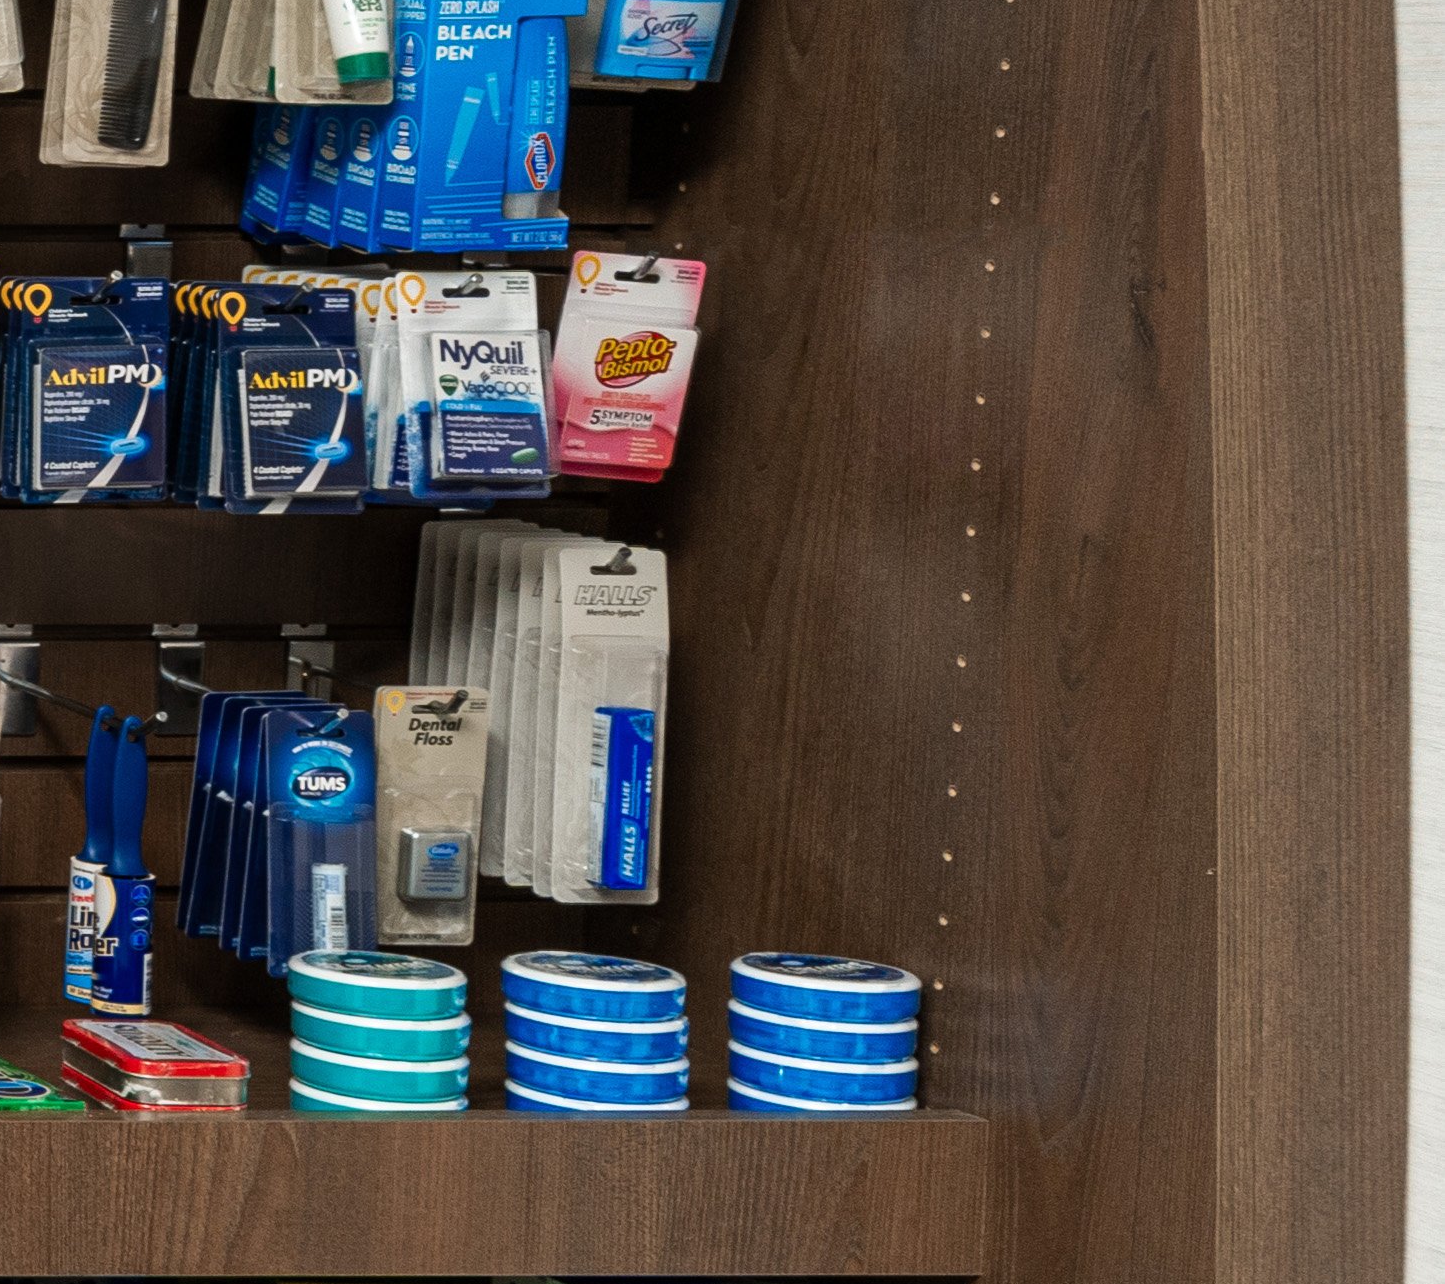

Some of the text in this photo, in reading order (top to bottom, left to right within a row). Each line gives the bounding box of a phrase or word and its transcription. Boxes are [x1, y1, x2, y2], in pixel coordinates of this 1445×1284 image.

[437, 24, 512, 42] BLEACH
[436, 45, 474, 62] PEN
[440, 340, 524, 367] NyQuil
[600, 355, 670, 379] Bismol
[602, 410, 654, 424] SYMPTOM
[575, 585, 653, 606] HALLS
[409, 717, 462, 735] Dental
[414, 731, 454, 747] Floss
[298, 774, 348, 793] TUMS
